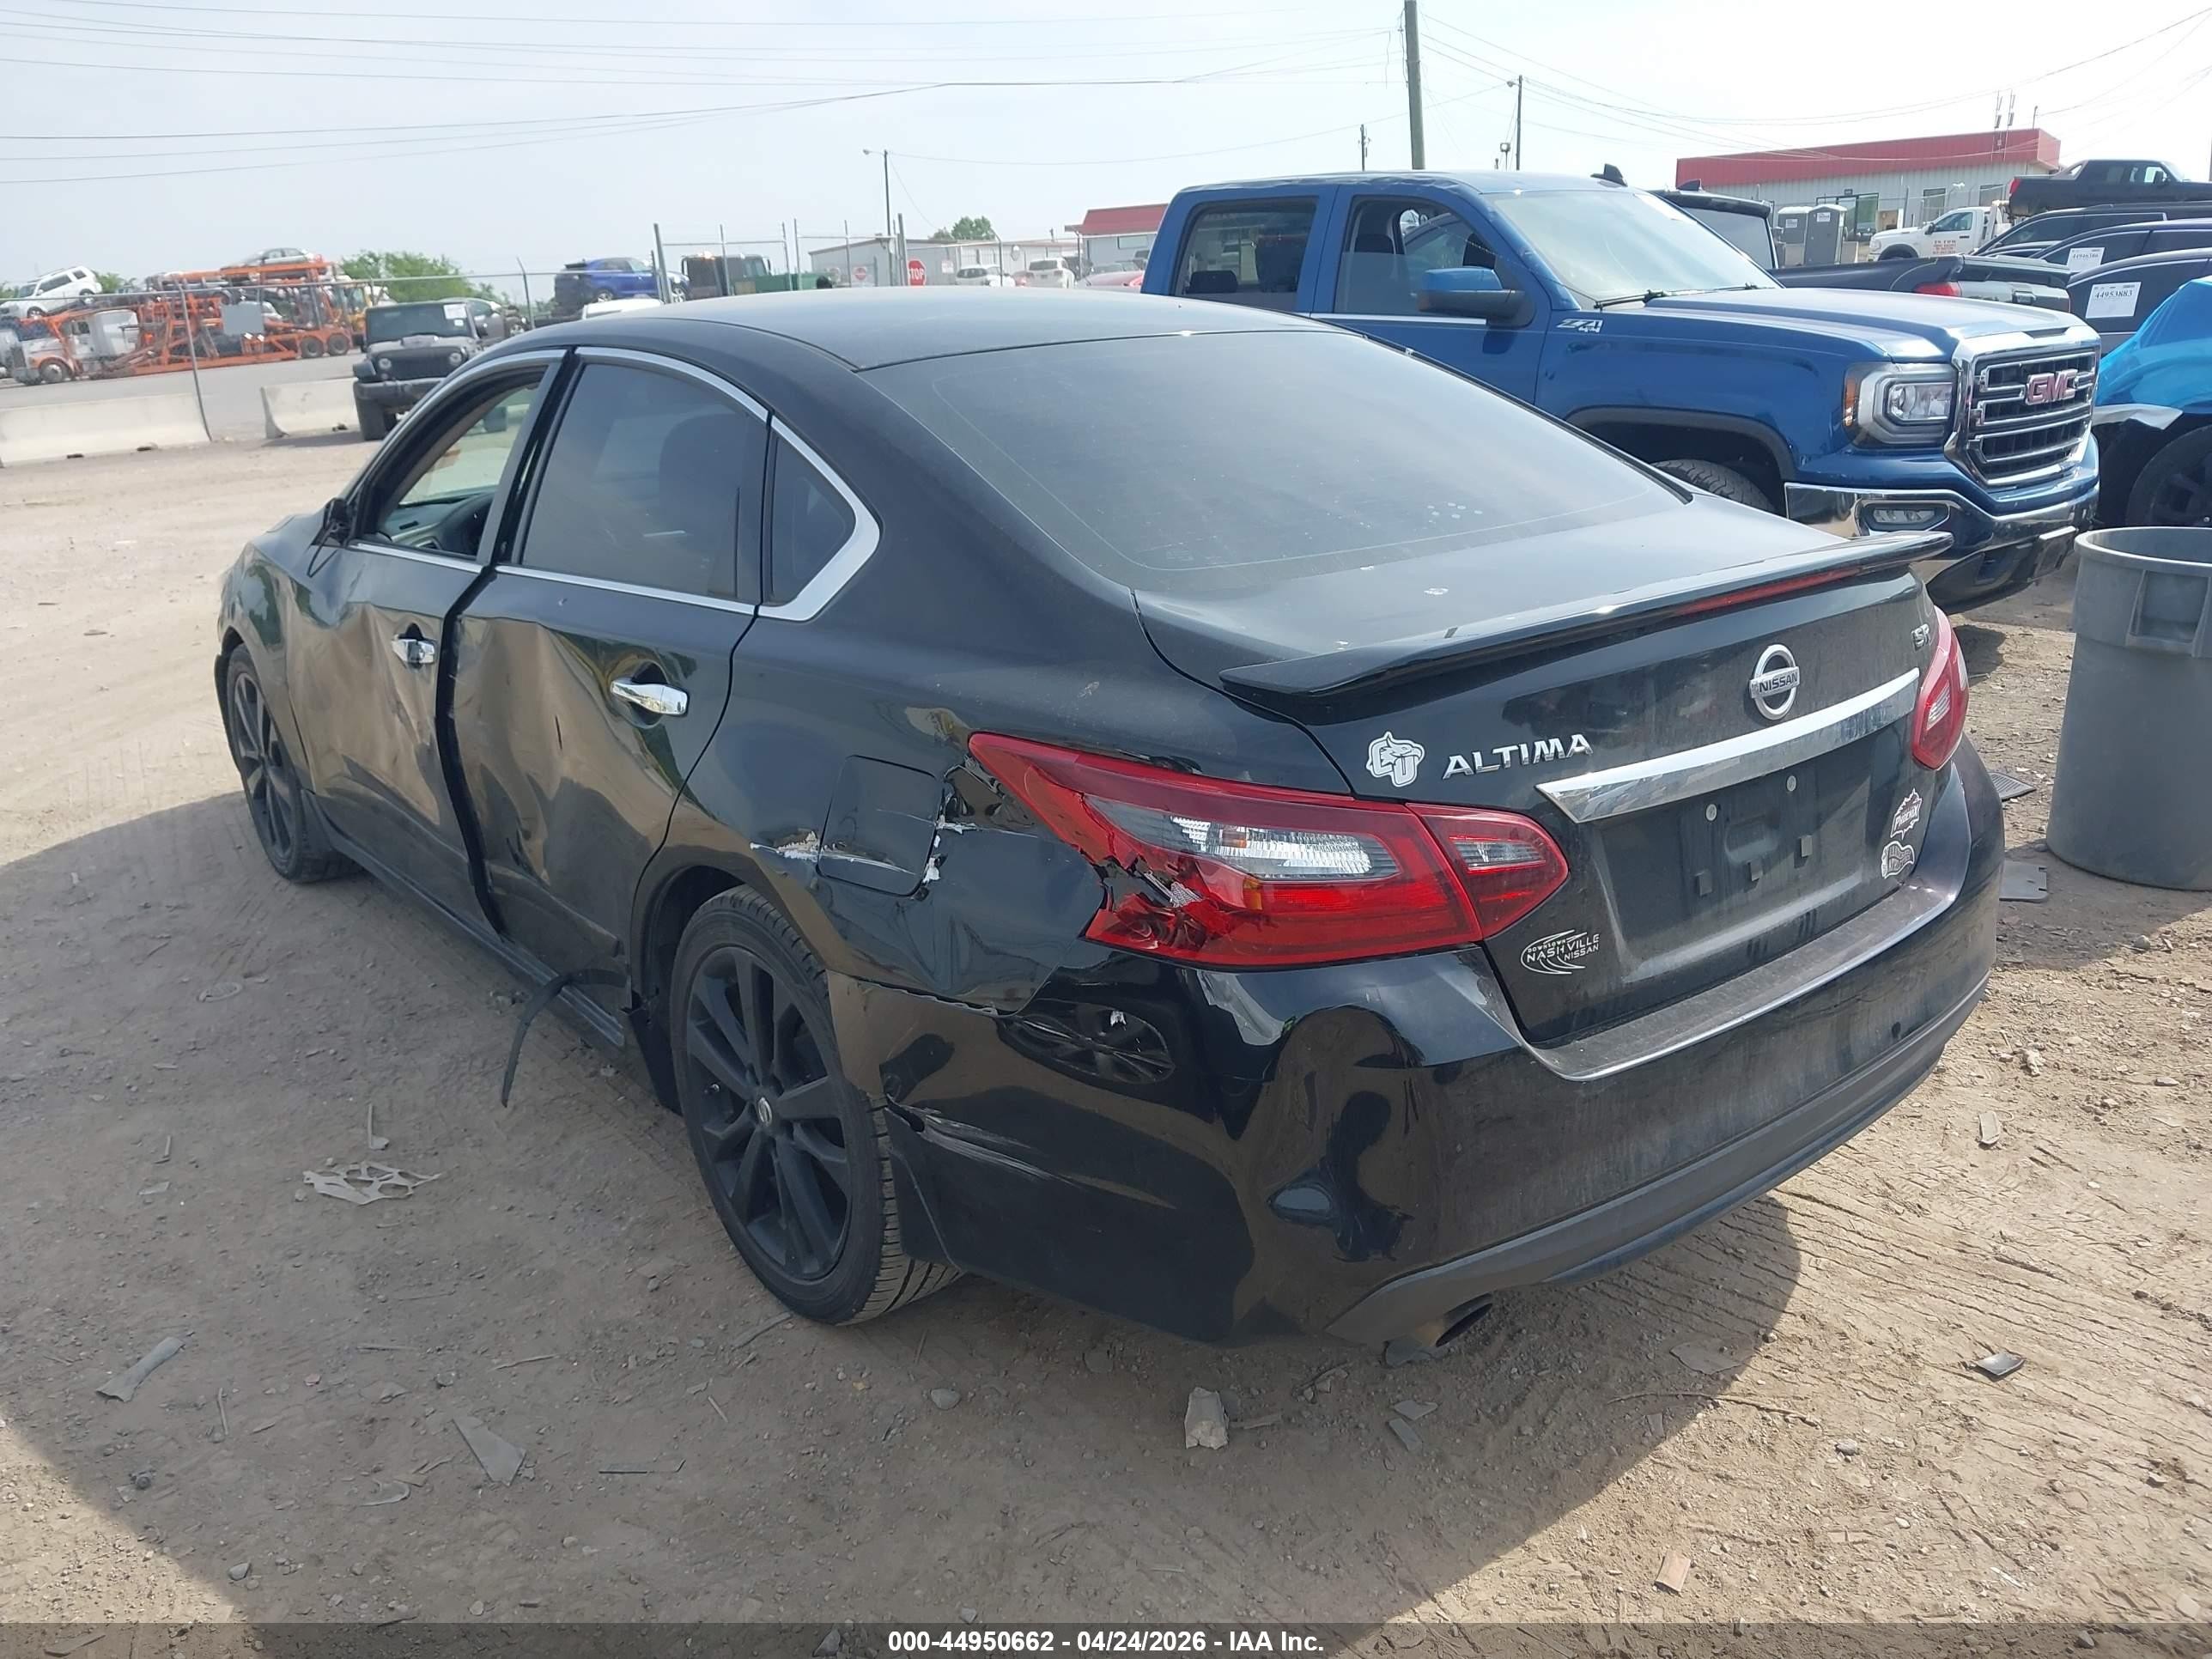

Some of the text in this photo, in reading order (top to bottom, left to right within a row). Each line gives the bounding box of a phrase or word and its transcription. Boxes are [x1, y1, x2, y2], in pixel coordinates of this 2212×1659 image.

[2026, 368, 2078, 405] GMC
[1911, 623, 1931, 648] SR
[1758, 672, 1798, 693] NISSAN
[1443, 733, 1594, 780] ALTIMA
[1527, 933, 1600, 963] NASHVILLE
[1528, 939, 1566, 953] DOWNTOWN
[1564, 943, 1599, 961] NISSAN
